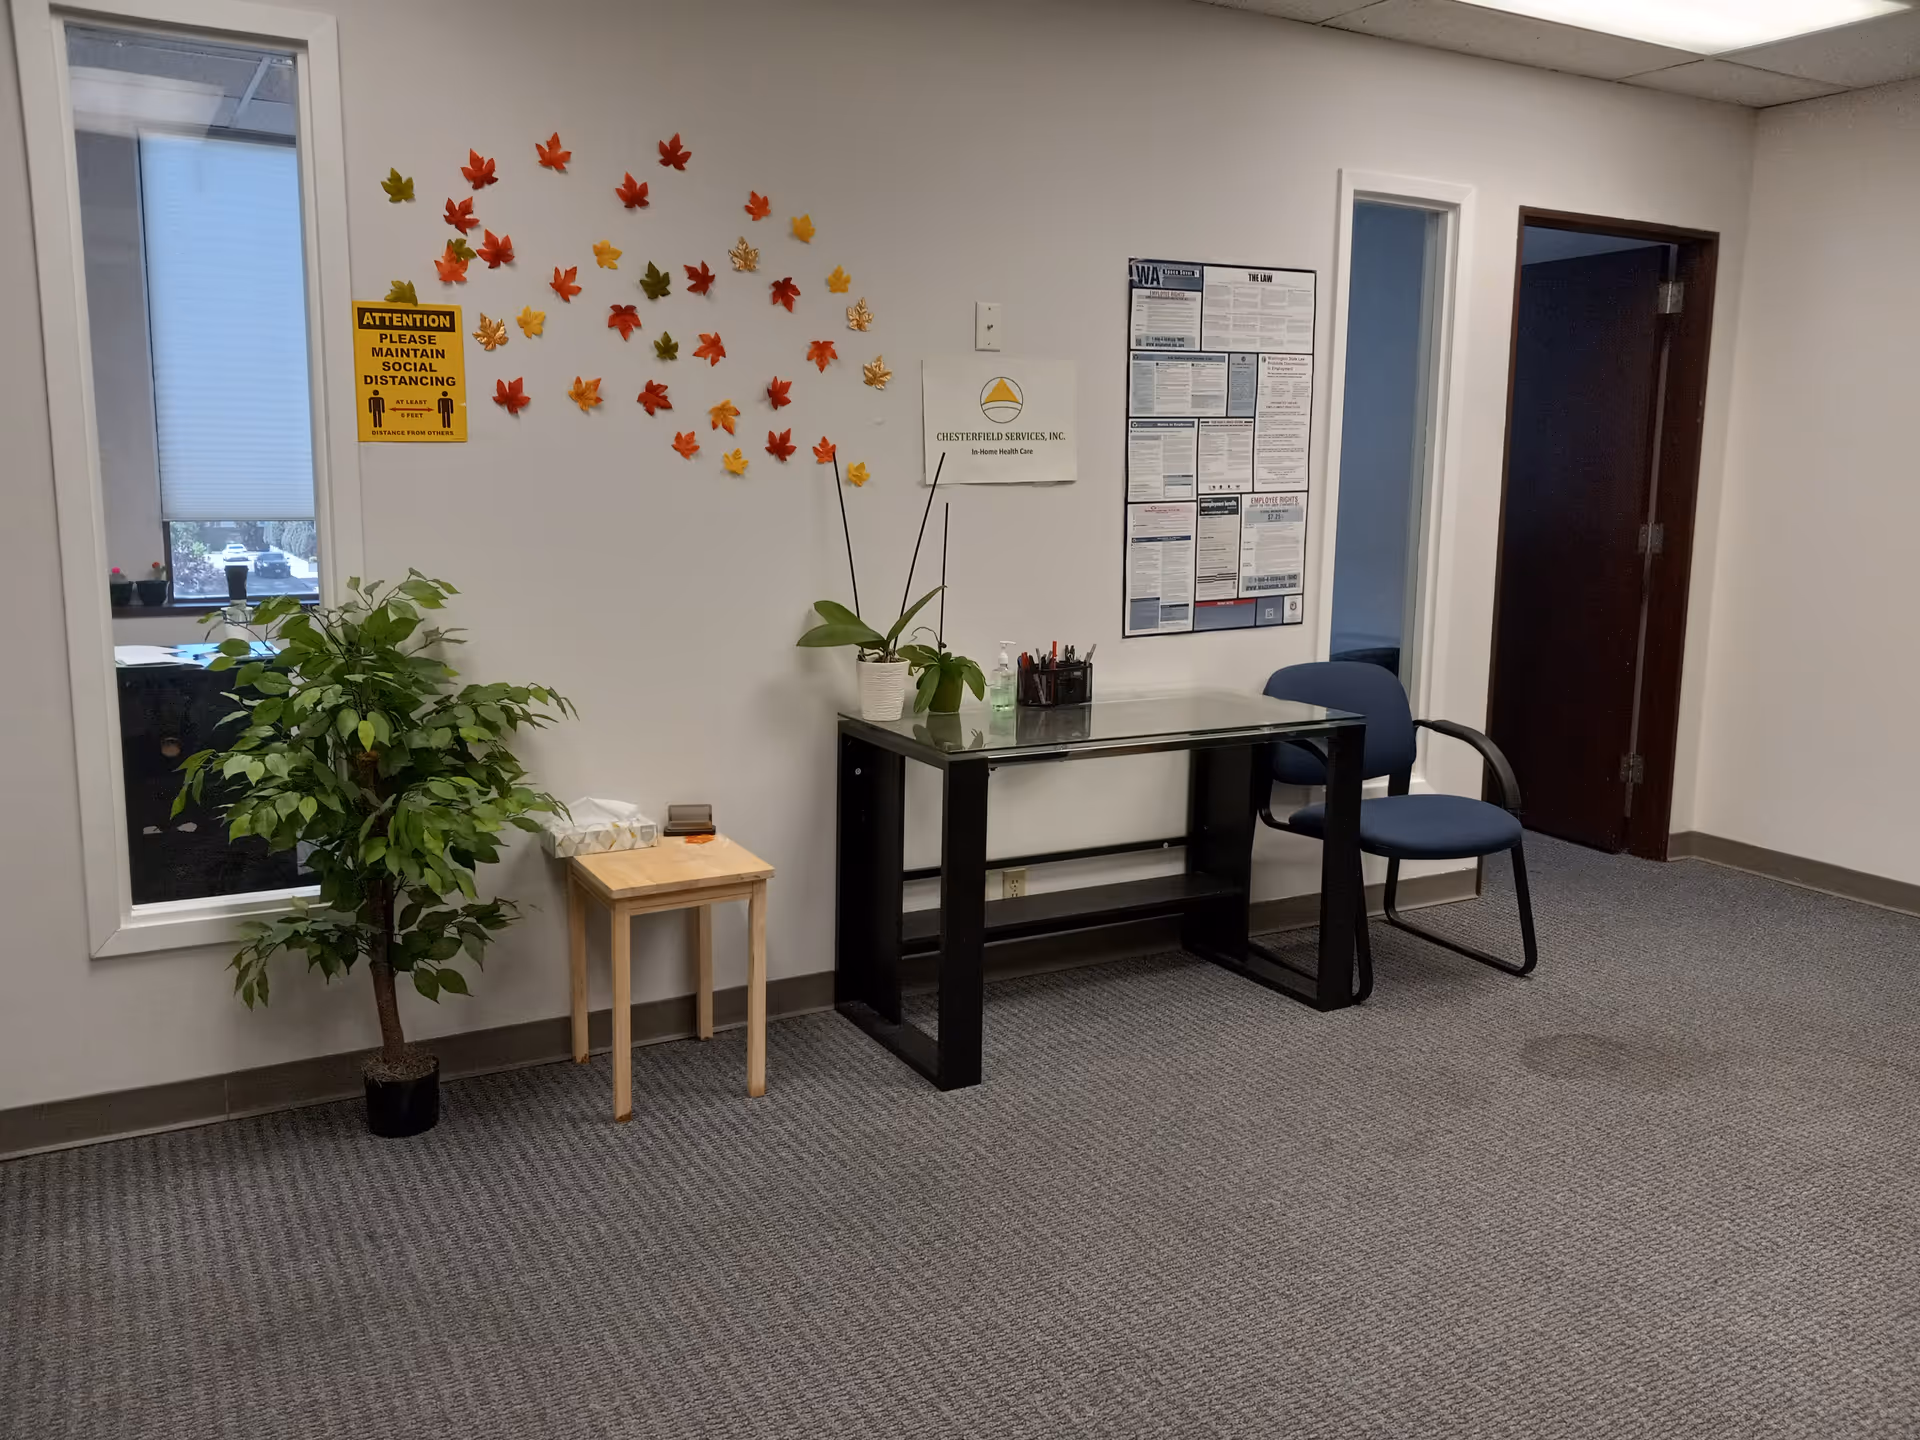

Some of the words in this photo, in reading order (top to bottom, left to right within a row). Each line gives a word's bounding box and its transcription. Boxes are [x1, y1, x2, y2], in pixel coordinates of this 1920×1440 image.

[1135, 264, 1161, 286] WA
[1248, 274, 1260, 282] THE
[1260, 274, 1273, 283] LAW
[362, 312, 451, 328] ATTENTION
[379, 333, 437, 345] PLEASE
[371, 347, 446, 359] MAINTAIN
[381, 361, 438, 373] SOCIAL
[363, 375, 456, 387] DISTANCING
[936, 432, 1003, 442] CHESTERFIELD
[1004, 432, 1048, 442] SERVICES,
[1050, 432, 1066, 441] INC.
[1250, 496, 1278, 504] EMPLOYEE
[1280, 496, 1298, 504] RIGHTS
